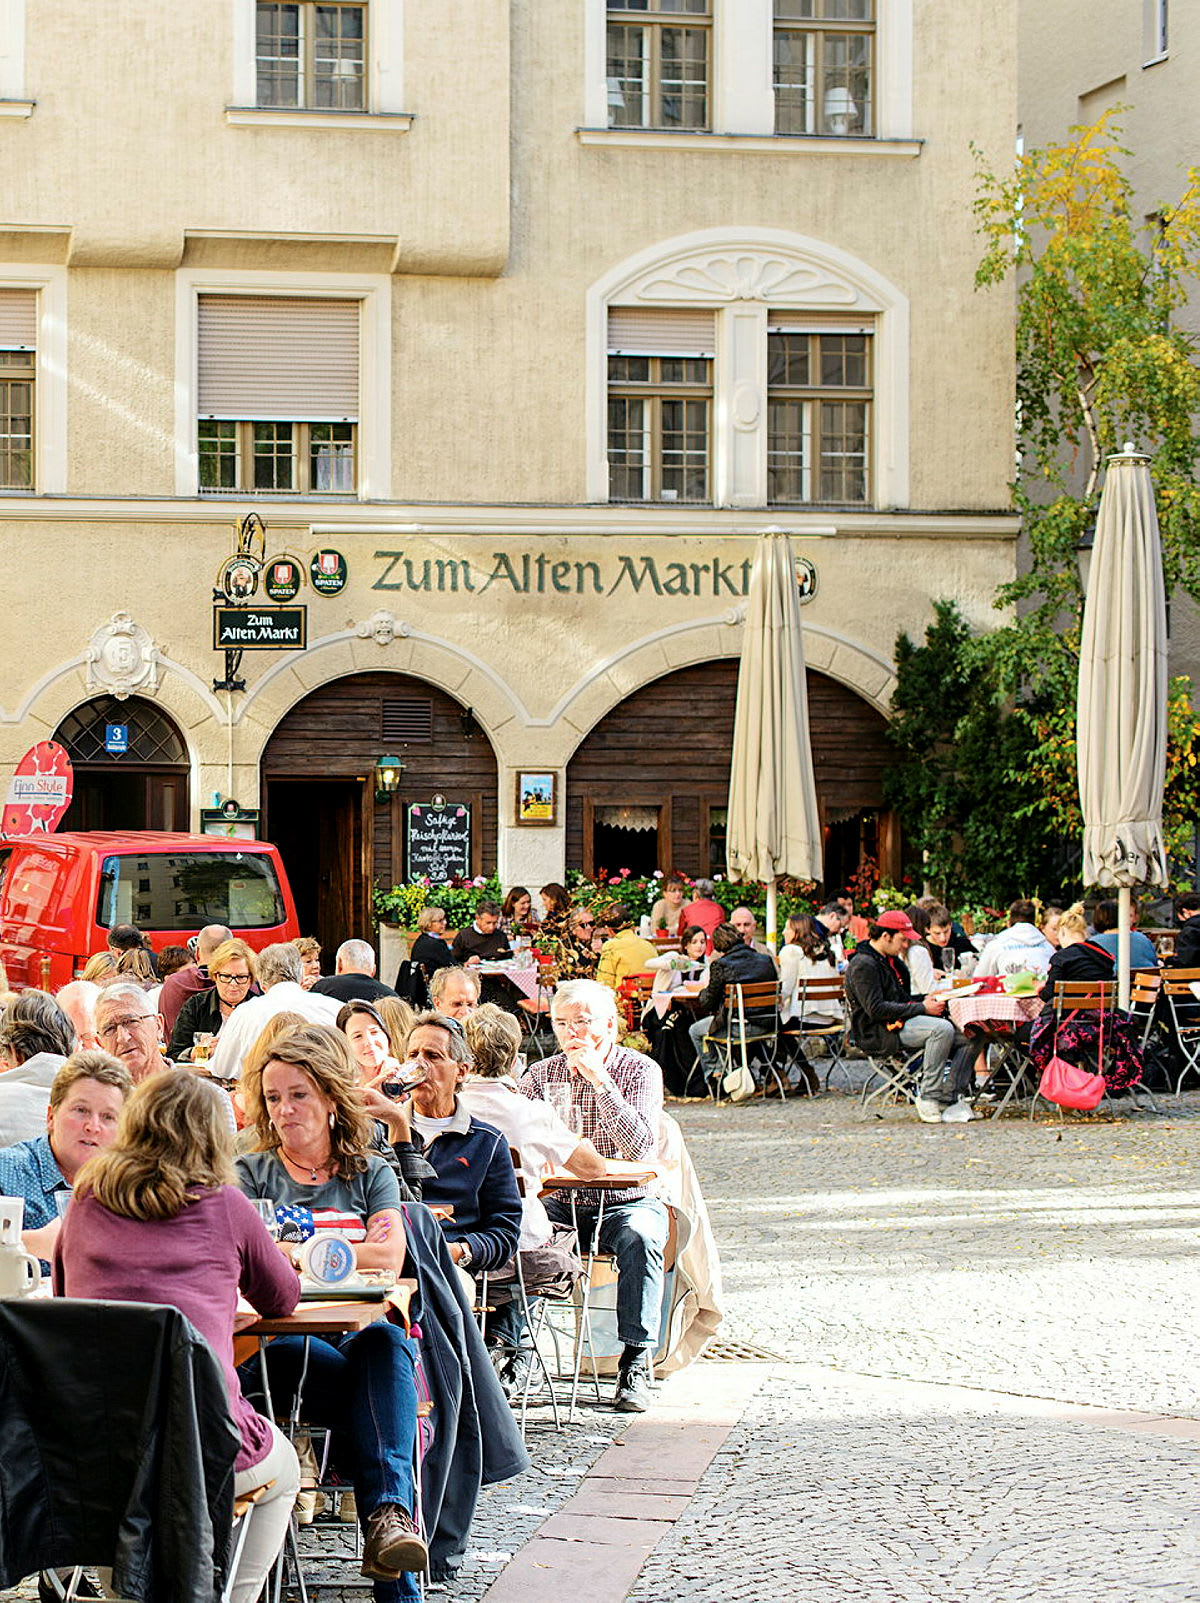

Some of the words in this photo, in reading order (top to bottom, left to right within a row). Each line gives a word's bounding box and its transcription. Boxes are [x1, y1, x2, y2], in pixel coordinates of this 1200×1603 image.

[370, 551, 476, 592] Zum
[477, 552, 605, 596] Alten
[606, 556, 754, 597] Markt
[314, 579, 343, 587] SPATEN
[246, 614, 274, 626] Zum
[220, 627, 257, 641] Alten
[256, 627, 299, 641] Markt
[112, 727, 122, 741] 3
[37, 779, 63, 792] Style
